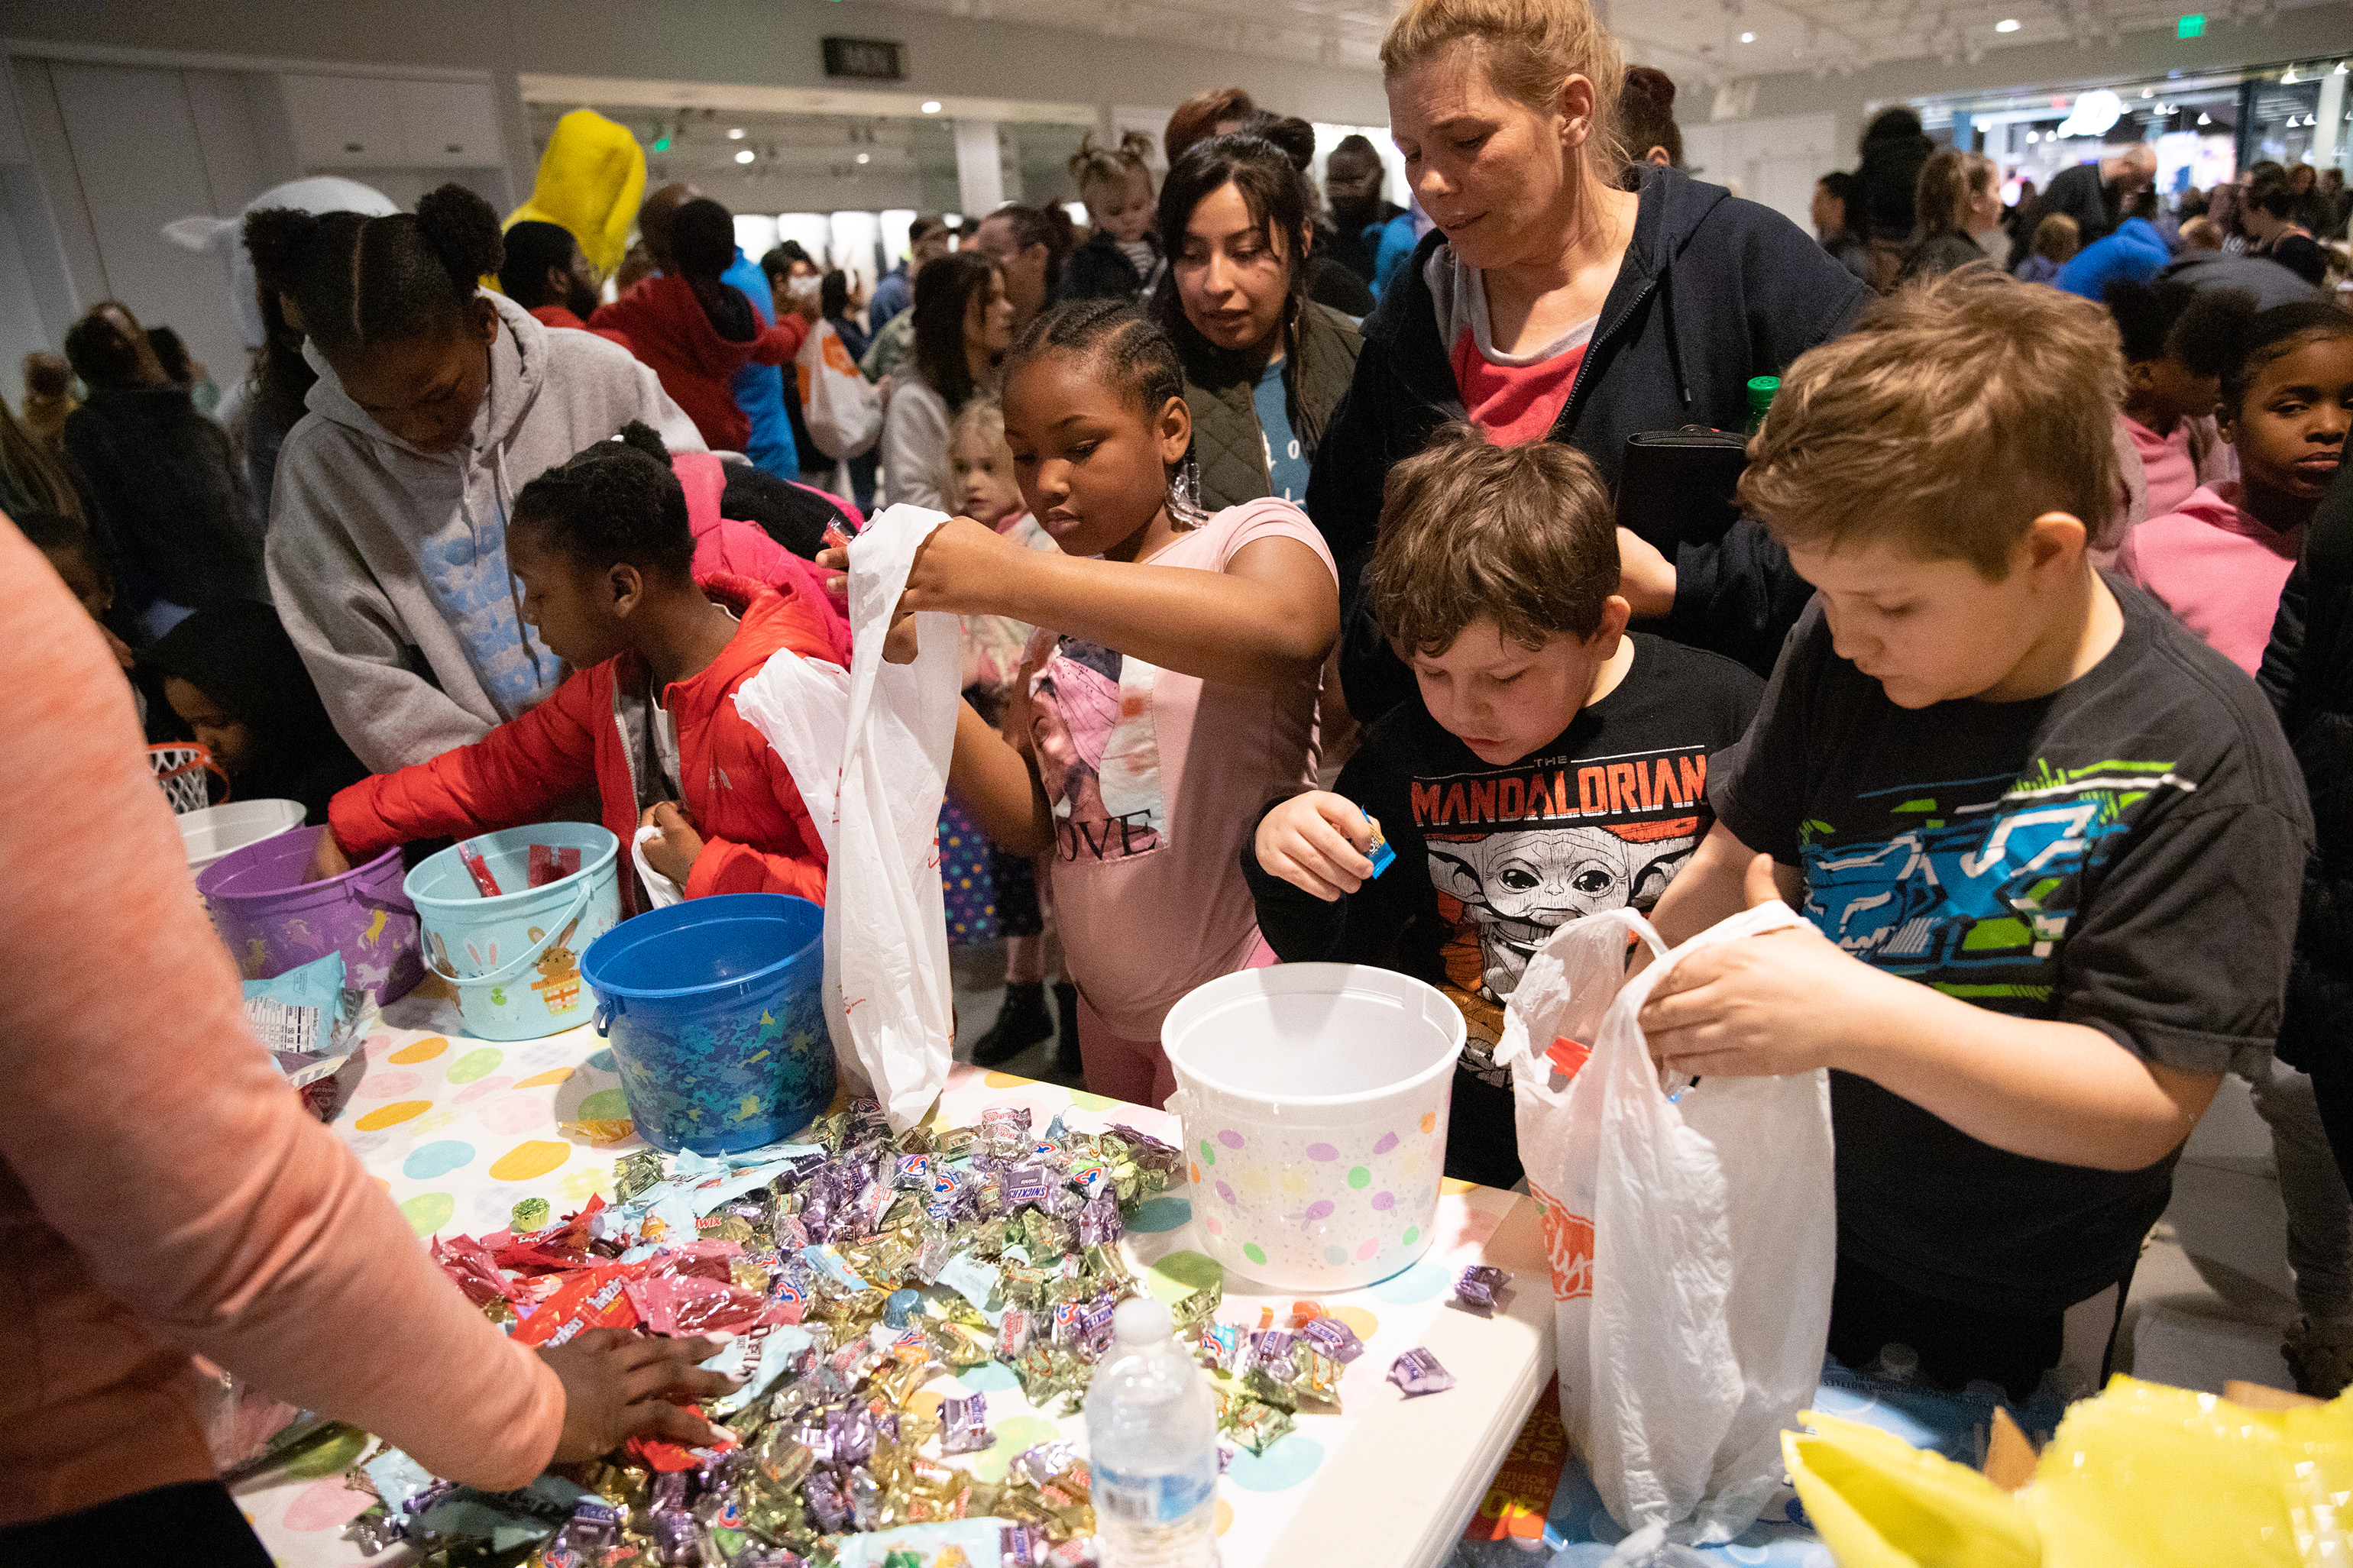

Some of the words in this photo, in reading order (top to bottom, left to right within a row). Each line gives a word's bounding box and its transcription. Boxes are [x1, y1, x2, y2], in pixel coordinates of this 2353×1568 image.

[1533, 755, 1568, 767] THE
[1410, 754, 1707, 827] MANDALORIAN
[1057, 808, 1157, 862] OVE
[1009, 1187, 1048, 1200] SNICKERS
[736, 1335, 745, 1350] SIZE
